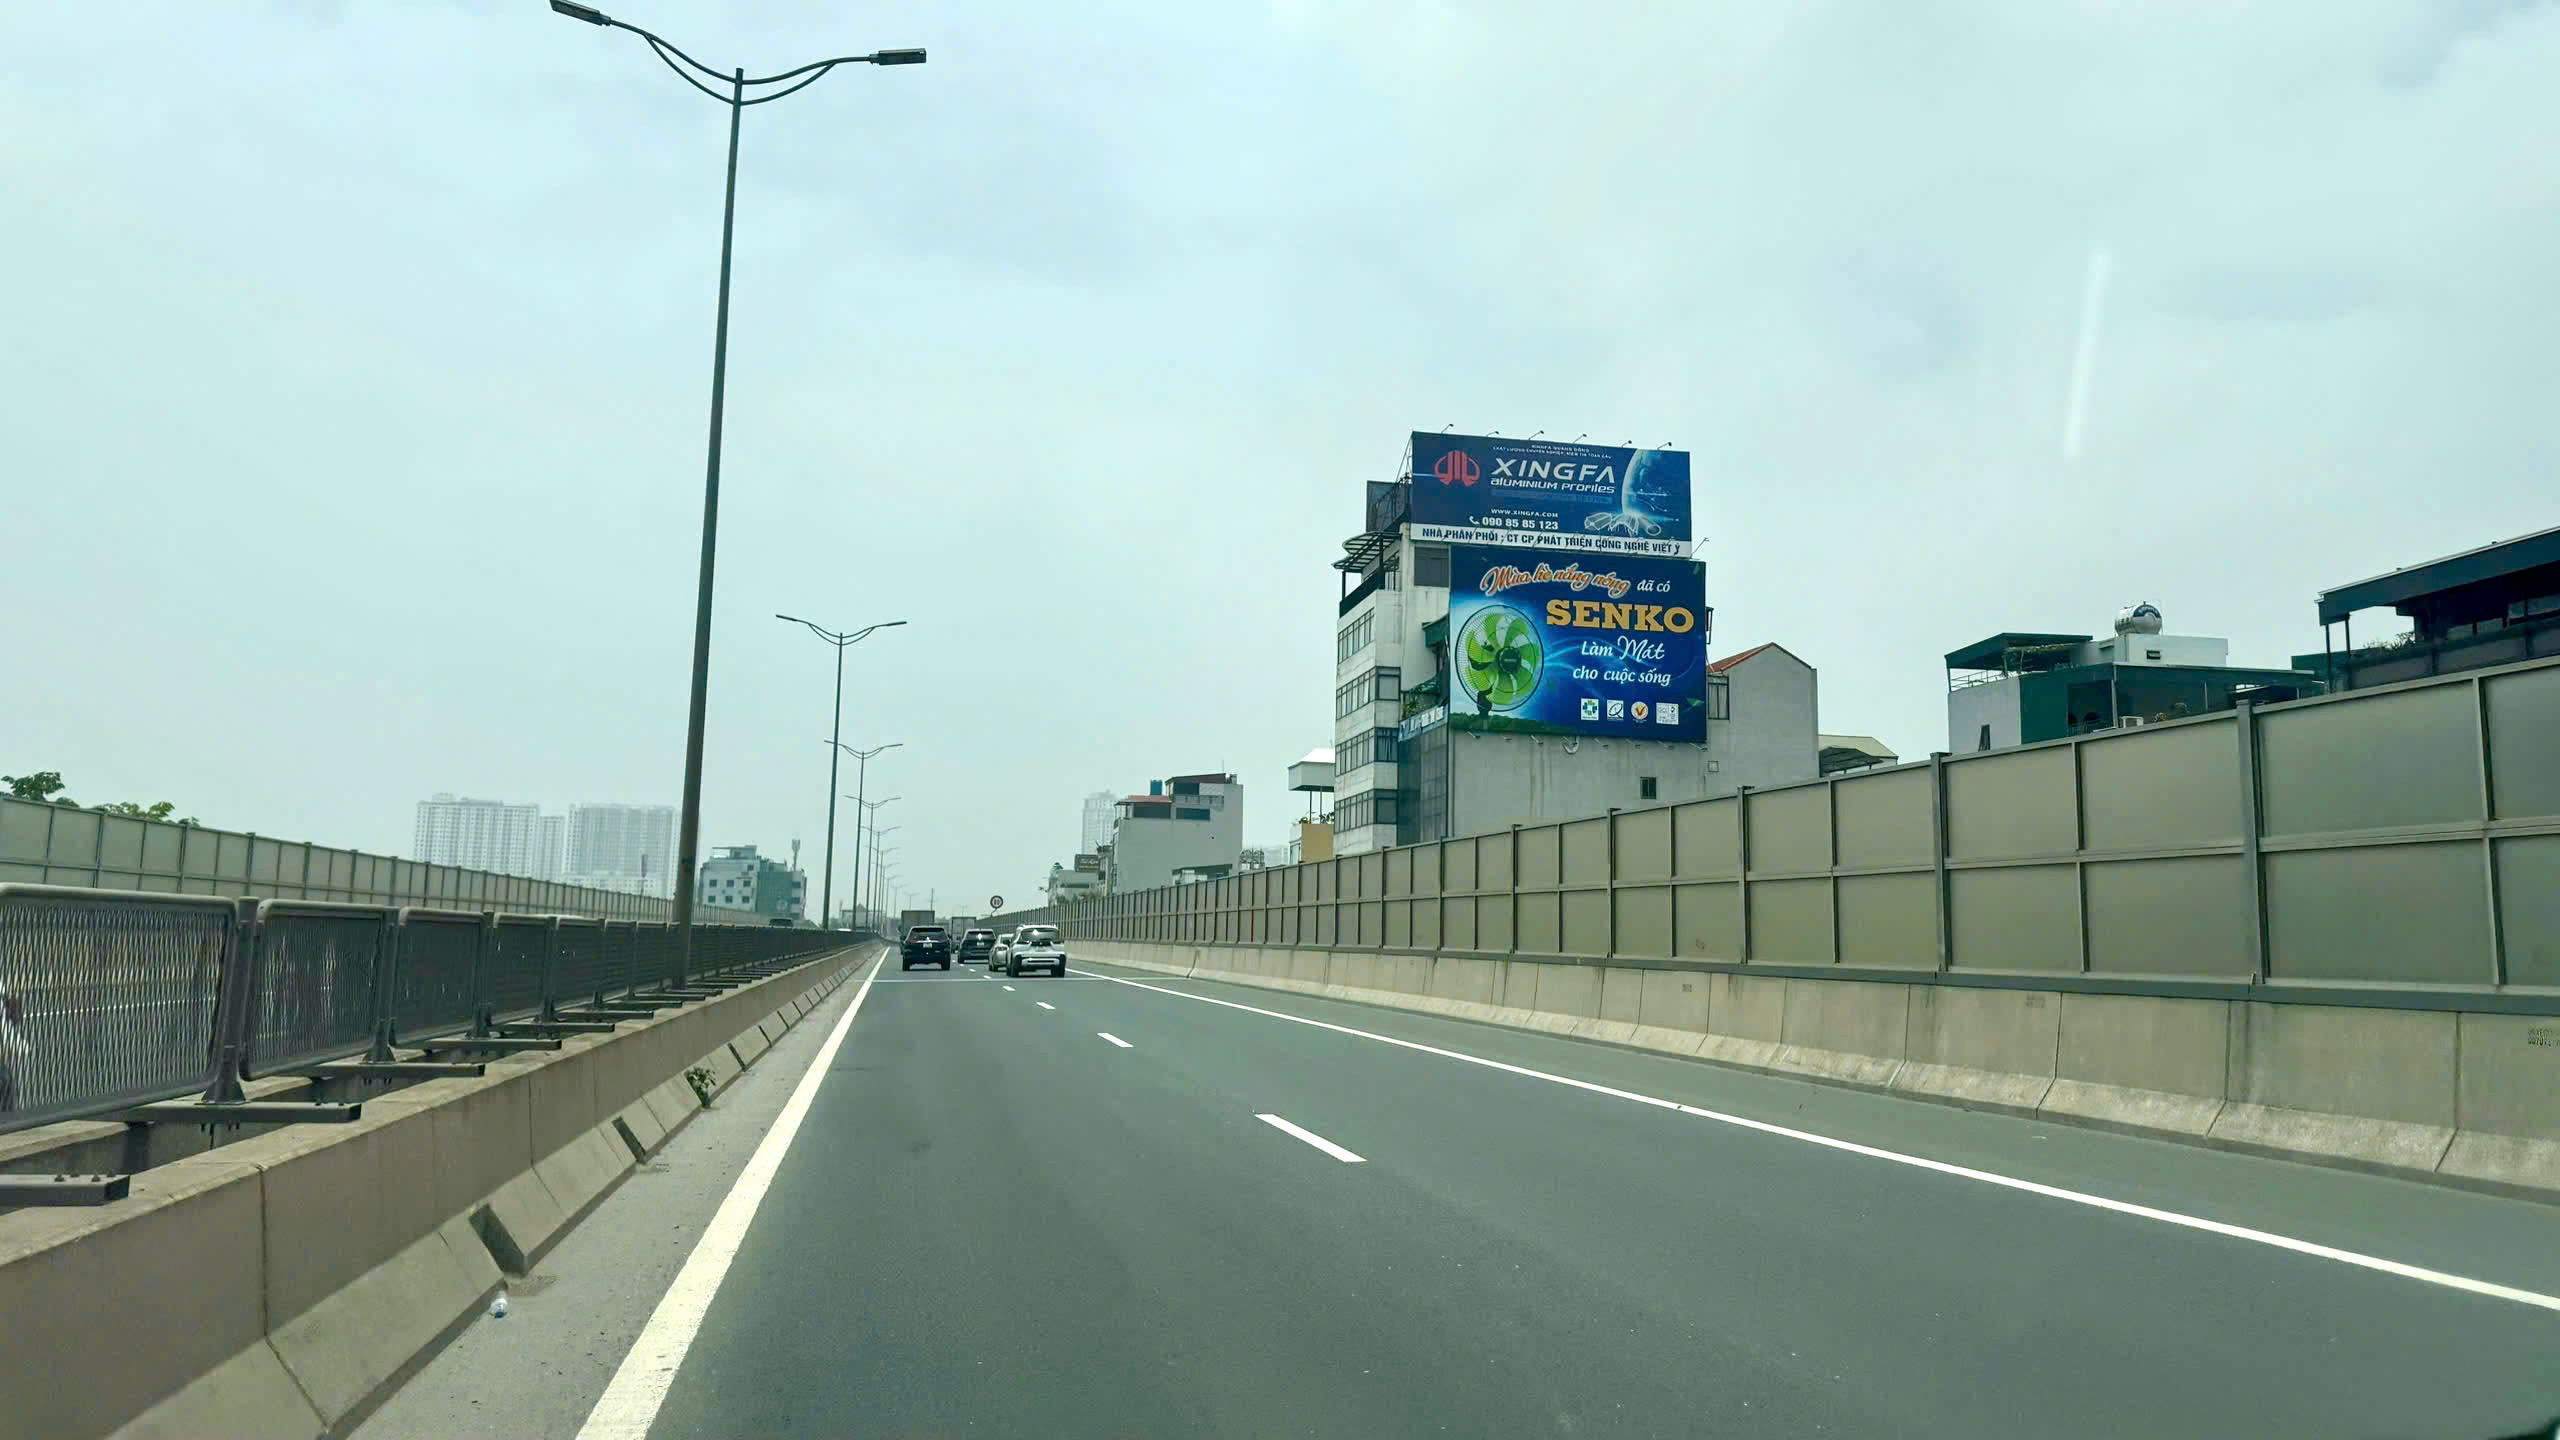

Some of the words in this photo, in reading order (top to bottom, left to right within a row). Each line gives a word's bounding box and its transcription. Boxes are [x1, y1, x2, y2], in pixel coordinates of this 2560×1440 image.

[1491, 458, 1616, 483] XINGFA
[1423, 527, 1442, 538] NHÀ
[1507, 533, 1519, 543] CT
[1521, 535, 1534, 544] CP
[1537, 535, 1561, 545] PHÁT
[1482, 517, 1502, 526] 090
[1506, 518, 1519, 527] 85
[1522, 519, 1535, 528] 85
[1539, 520, 1558, 530] 123
[1480, 565, 1530, 596] Mùa
[1532, 562, 1553, 583] hè
[1553, 562, 1593, 591] nắng
[1591, 571, 1631, 599] nóng
[1637, 580, 1654, 592] đã
[1656, 580, 1671, 593] có
[1546, 599, 1694, 633] SENKO
[1581, 641, 1614, 657] Làm
[1617, 635, 1665, 662] Mát
[1573, 666, 1598, 680] cho
[1603, 668, 1636, 684] cuộc
[1638, 668, 1671, 686] sống
